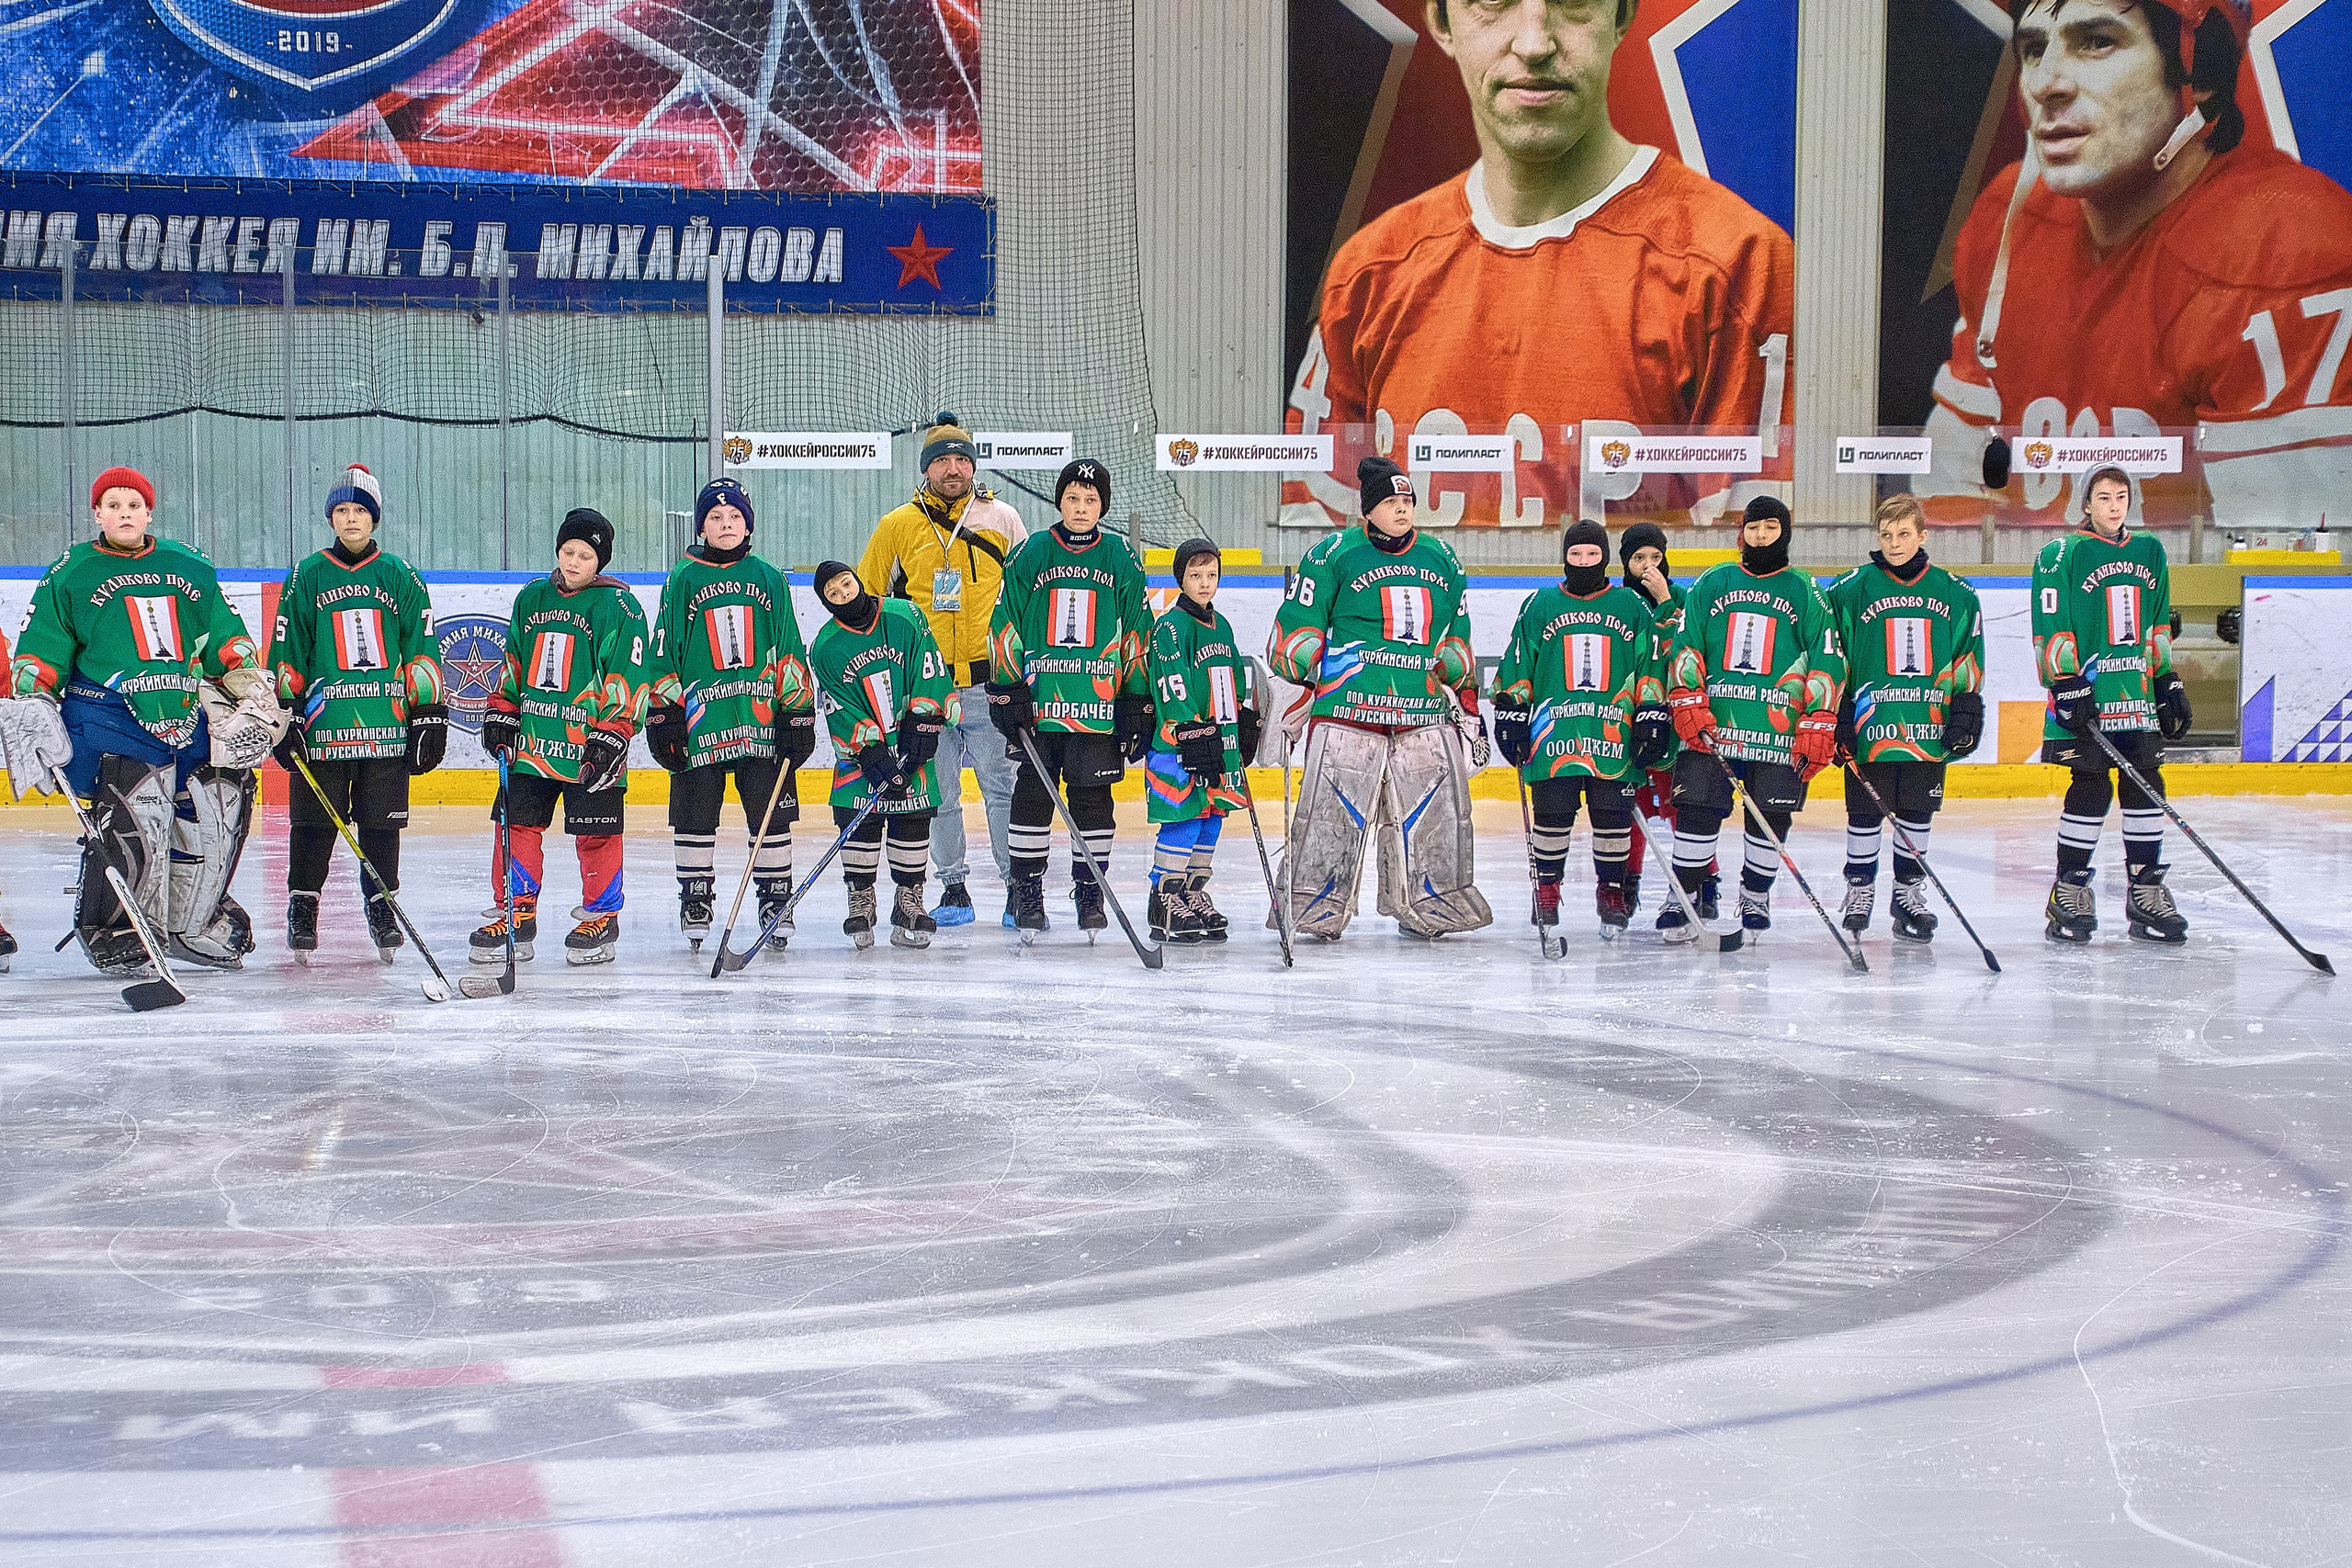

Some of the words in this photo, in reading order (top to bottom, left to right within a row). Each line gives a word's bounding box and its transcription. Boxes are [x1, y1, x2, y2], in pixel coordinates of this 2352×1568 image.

[0, 209, 78, 268] ИЯ
[89, 212, 300, 273] ХОККЕЯ
[311, 219, 401, 276] ИМ.
[537, 216, 843, 284] МИХАЙЛОВА
[2242, 287, 2352, 412] 17
[756, 442, 876, 459] #ХОККЕЙРОССИИ75
[996, 446, 1066, 457] ПОЛИПЛАСТ
[1203, 444, 1318, 461] #ХОККЕЙРОССИИ75
[1435, 448, 1502, 459] ПОЛИПЛАСТ
[1634, 445, 1747, 463] #ХОККЕЙРОССИИ75
[1859, 450, 1925, 462] ПОЛИПЛАСТ
[2057, 446, 2168, 463] #ХОККЕЙРОССИИ75
[1091, 568, 1115, 592] ПОЛ
[1350, 564, 1417, 593] КУЛИКОВО
[2081, 560, 2134, 594] КУЛИКОВО
[90, 572, 161, 608] КУЛИКОВО
[165, 573, 201, 603] ПОЛЕ
[1285, 572, 1316, 608] 96
[1860, 595, 1924, 625] КУЛИКОВО
[1926, 597, 1951, 621] ПОЛ
[1541, 611, 1601, 642] КУЛИКОВО
[1604, 614, 1635, 643] ПОЛЕ
[630, 635, 643, 667] 8
[1358, 649, 1422, 671] КУРКИНСКИЙ
[1085, 659, 1115, 675] РАЙОН
[1157, 672, 1188, 704] 76
[1760, 686, 1790, 705] РАЙОН
[1870, 687, 1921, 705] КУРКИНСКИЙ
[2057, 686, 2092, 701] PRIME
[1346, 690, 1363, 704] ООО
[1367, 694, 1424, 709] КУРКИНСКАЯ
[560, 705, 587, 723] РАЙОН
[1044, 699, 1114, 721] ГОРБАЧЁВ
[1333, 705, 1351, 719] ООО
[1354, 706, 1399, 724] РУССКИЙ
[1597, 704, 1624, 722] РАЙОН
[413, 717, 442, 727] MAD
[336, 727, 397, 741] КУРКИНСКАЯ
[697, 733, 718, 749] ООО
[1178, 726, 1217, 741] ESPO
[1867, 724, 1898, 742] ООО
[325, 743, 371, 760] РУССКИЙ
[1545, 739, 1576, 757] ООО
[1580, 736, 1625, 760] ДЖЕМ
[569, 816, 618, 825] EASTON
